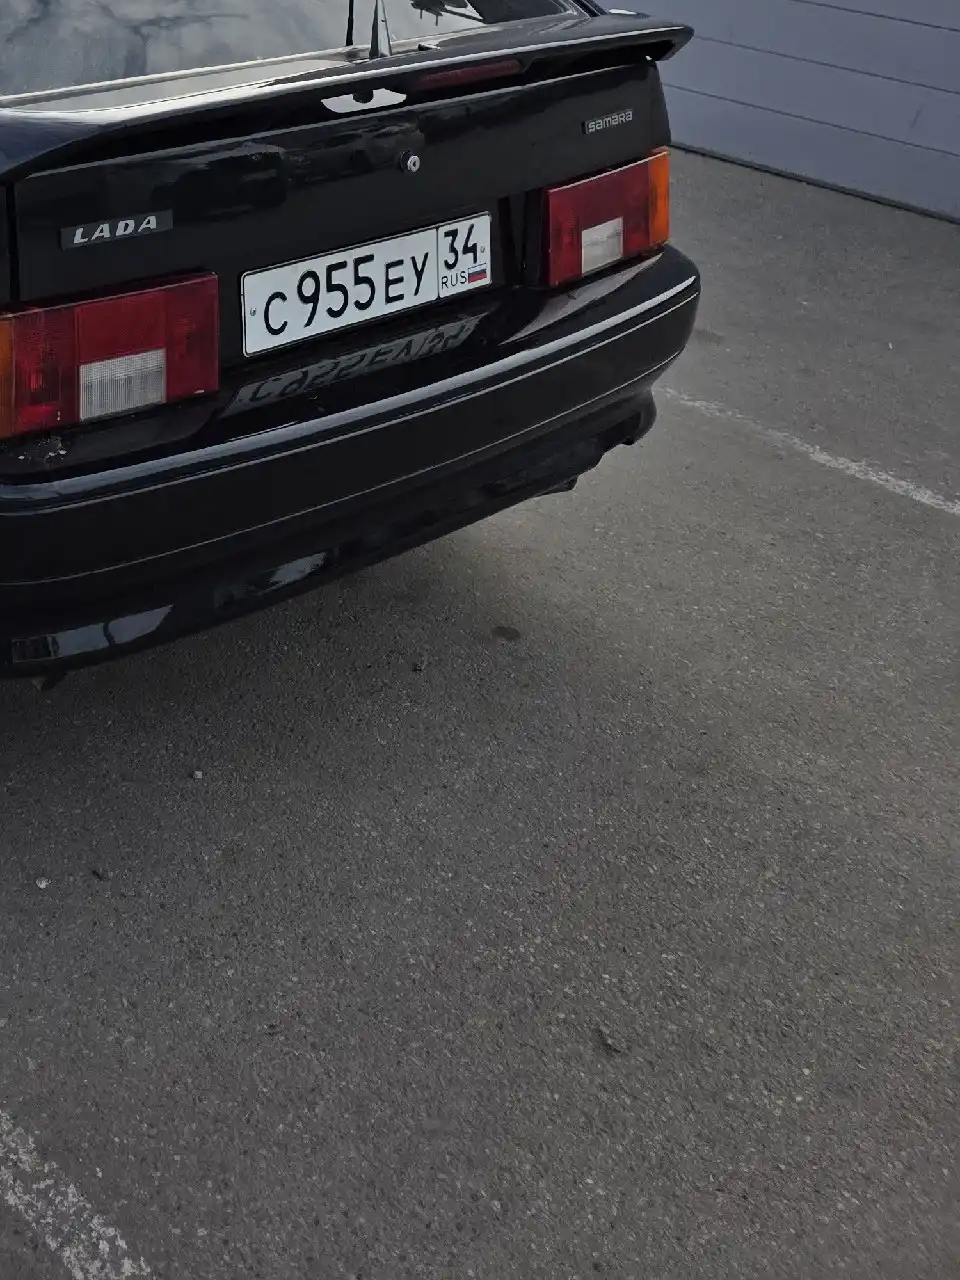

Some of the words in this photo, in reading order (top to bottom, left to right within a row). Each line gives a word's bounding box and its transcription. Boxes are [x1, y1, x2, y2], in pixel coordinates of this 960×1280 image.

[73, 215, 157, 244] LADA
[443, 223, 479, 270] 34
[441, 270, 467, 290] RUS
